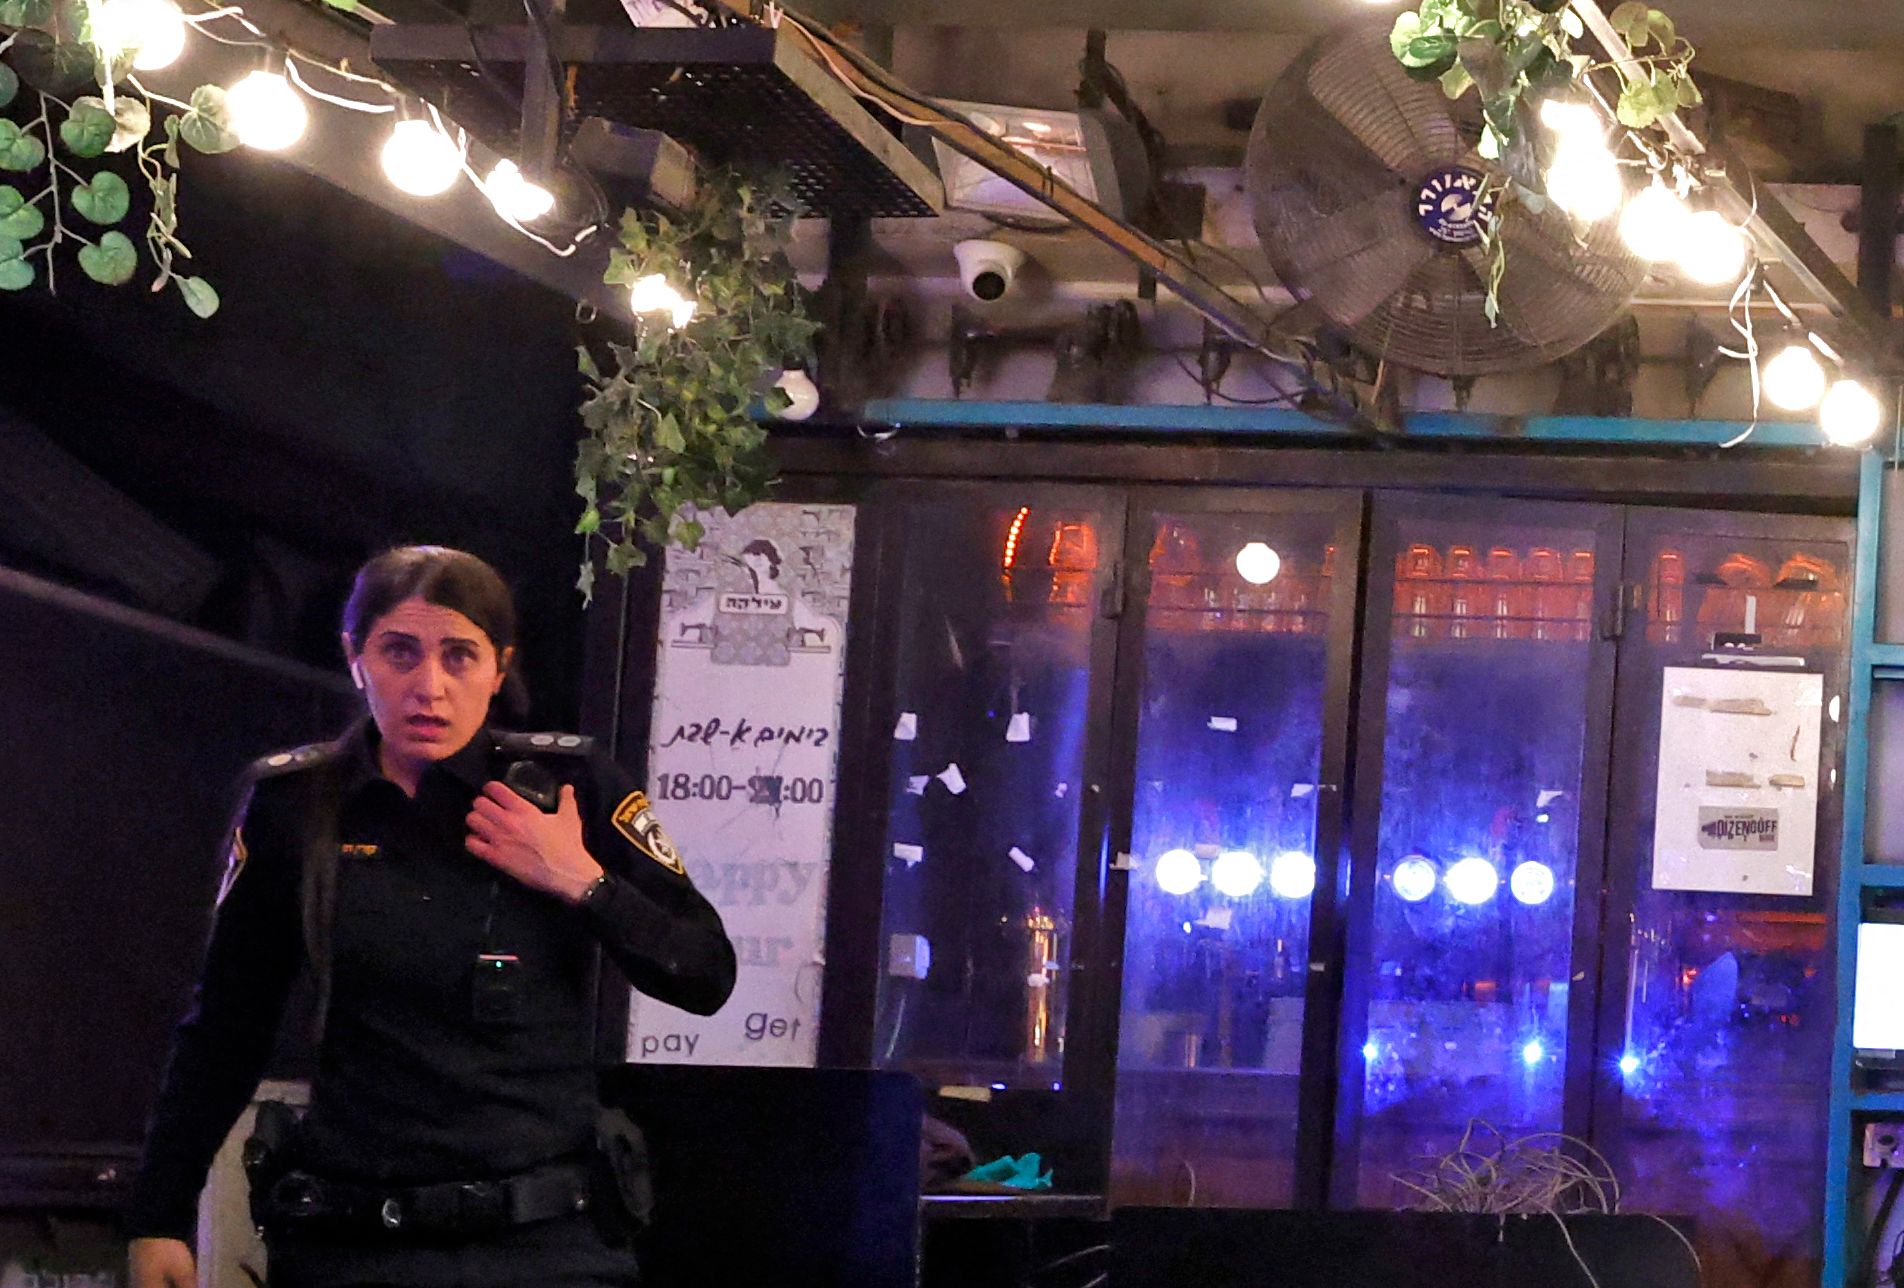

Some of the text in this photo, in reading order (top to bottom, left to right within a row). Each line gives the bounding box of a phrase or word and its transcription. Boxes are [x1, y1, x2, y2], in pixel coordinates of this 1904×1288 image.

[690, 857, 818, 906] appy
[745, 1012, 802, 1040] get
[642, 1033, 700, 1058] pay
